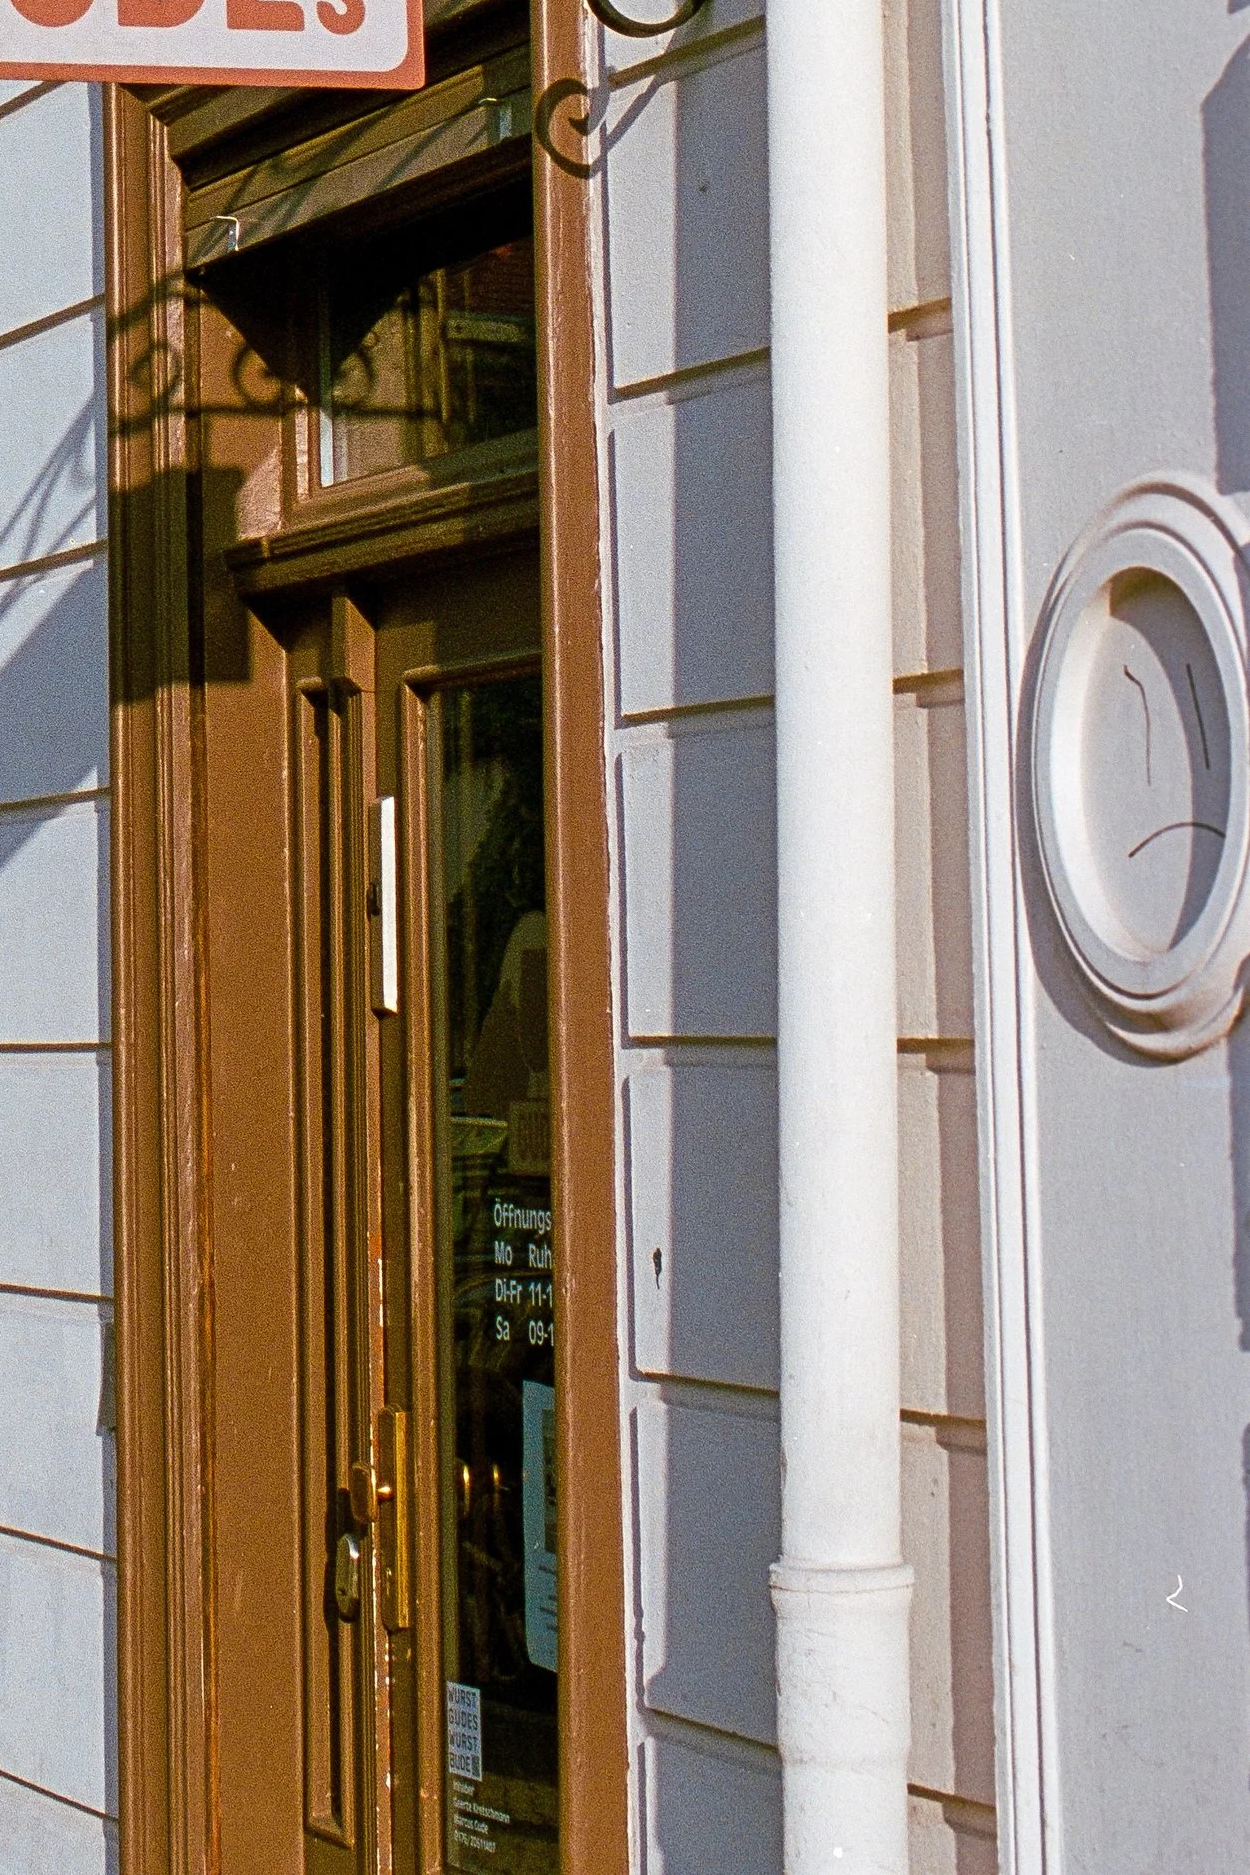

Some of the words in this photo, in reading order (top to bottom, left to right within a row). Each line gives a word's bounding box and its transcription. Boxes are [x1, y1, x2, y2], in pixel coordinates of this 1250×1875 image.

[493, 1198, 552, 1235] Öffnungs
[494, 1240, 513, 1266] Mo
[495, 1315, 510, 1342] Sa
